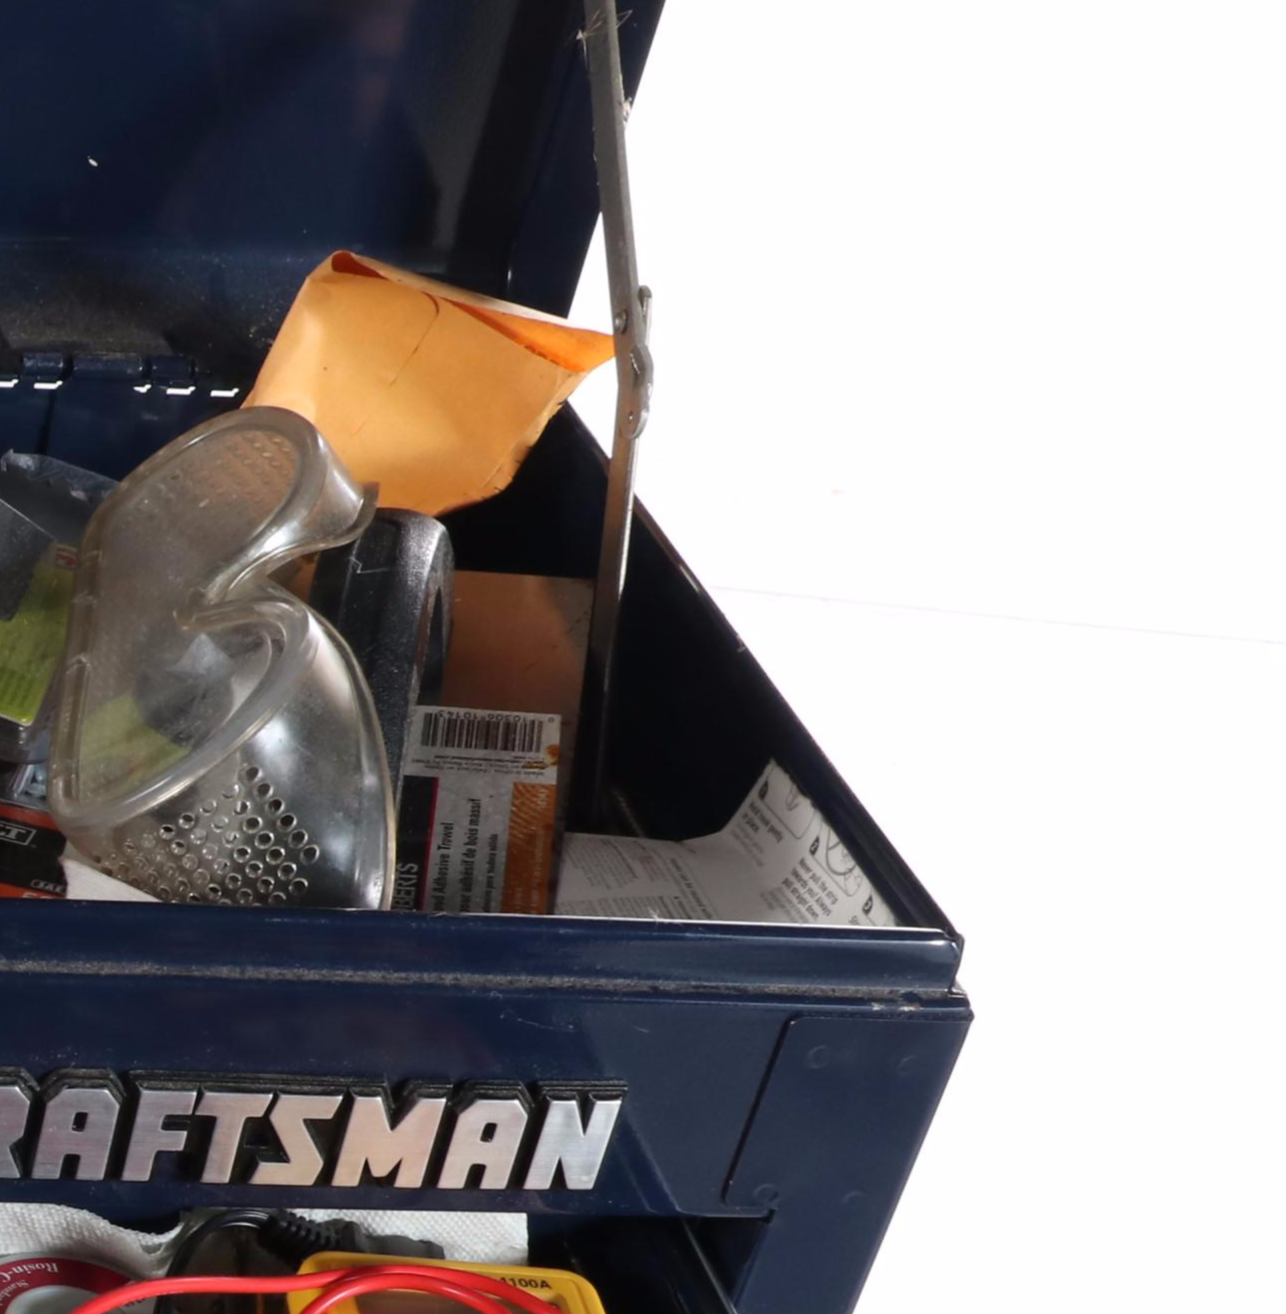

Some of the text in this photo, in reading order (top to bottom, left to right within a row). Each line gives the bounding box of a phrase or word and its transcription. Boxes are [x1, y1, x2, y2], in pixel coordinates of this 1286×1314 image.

[436, 820, 454, 851] Trowel
[464, 827, 478, 846] bois
[462, 846, 475, 858] de
[431, 852, 450, 893] Adhesive
[796, 856, 814, 876] Never
